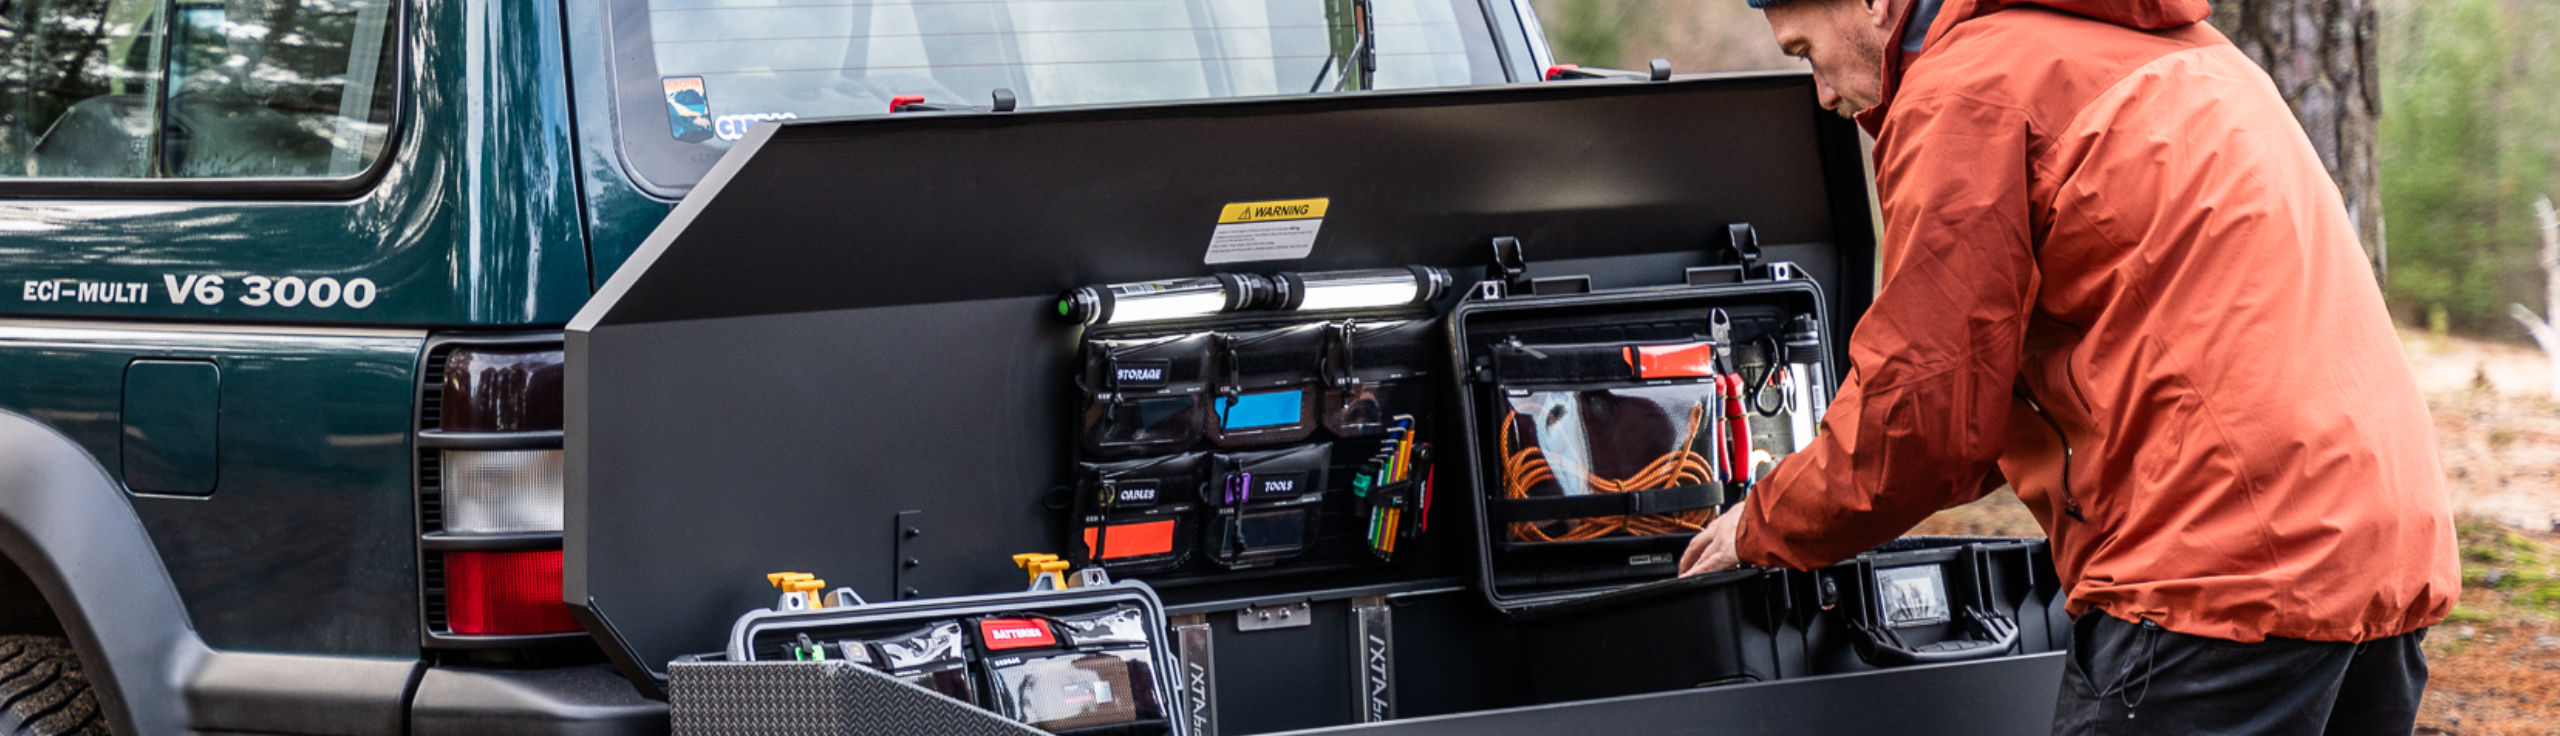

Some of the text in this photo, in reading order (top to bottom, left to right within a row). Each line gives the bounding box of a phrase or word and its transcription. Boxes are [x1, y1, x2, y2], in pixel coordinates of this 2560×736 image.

[1255, 204, 1309, 217] WARNING
[23, 274, 376, 308] ECI-MULTI V6 3000
[1117, 368, 1162, 380] STORAGE
[1265, 480, 1294, 492] TOOLS
[1121, 489, 1155, 501] CABLES
[992, 628, 1042, 641] BATTERIES
